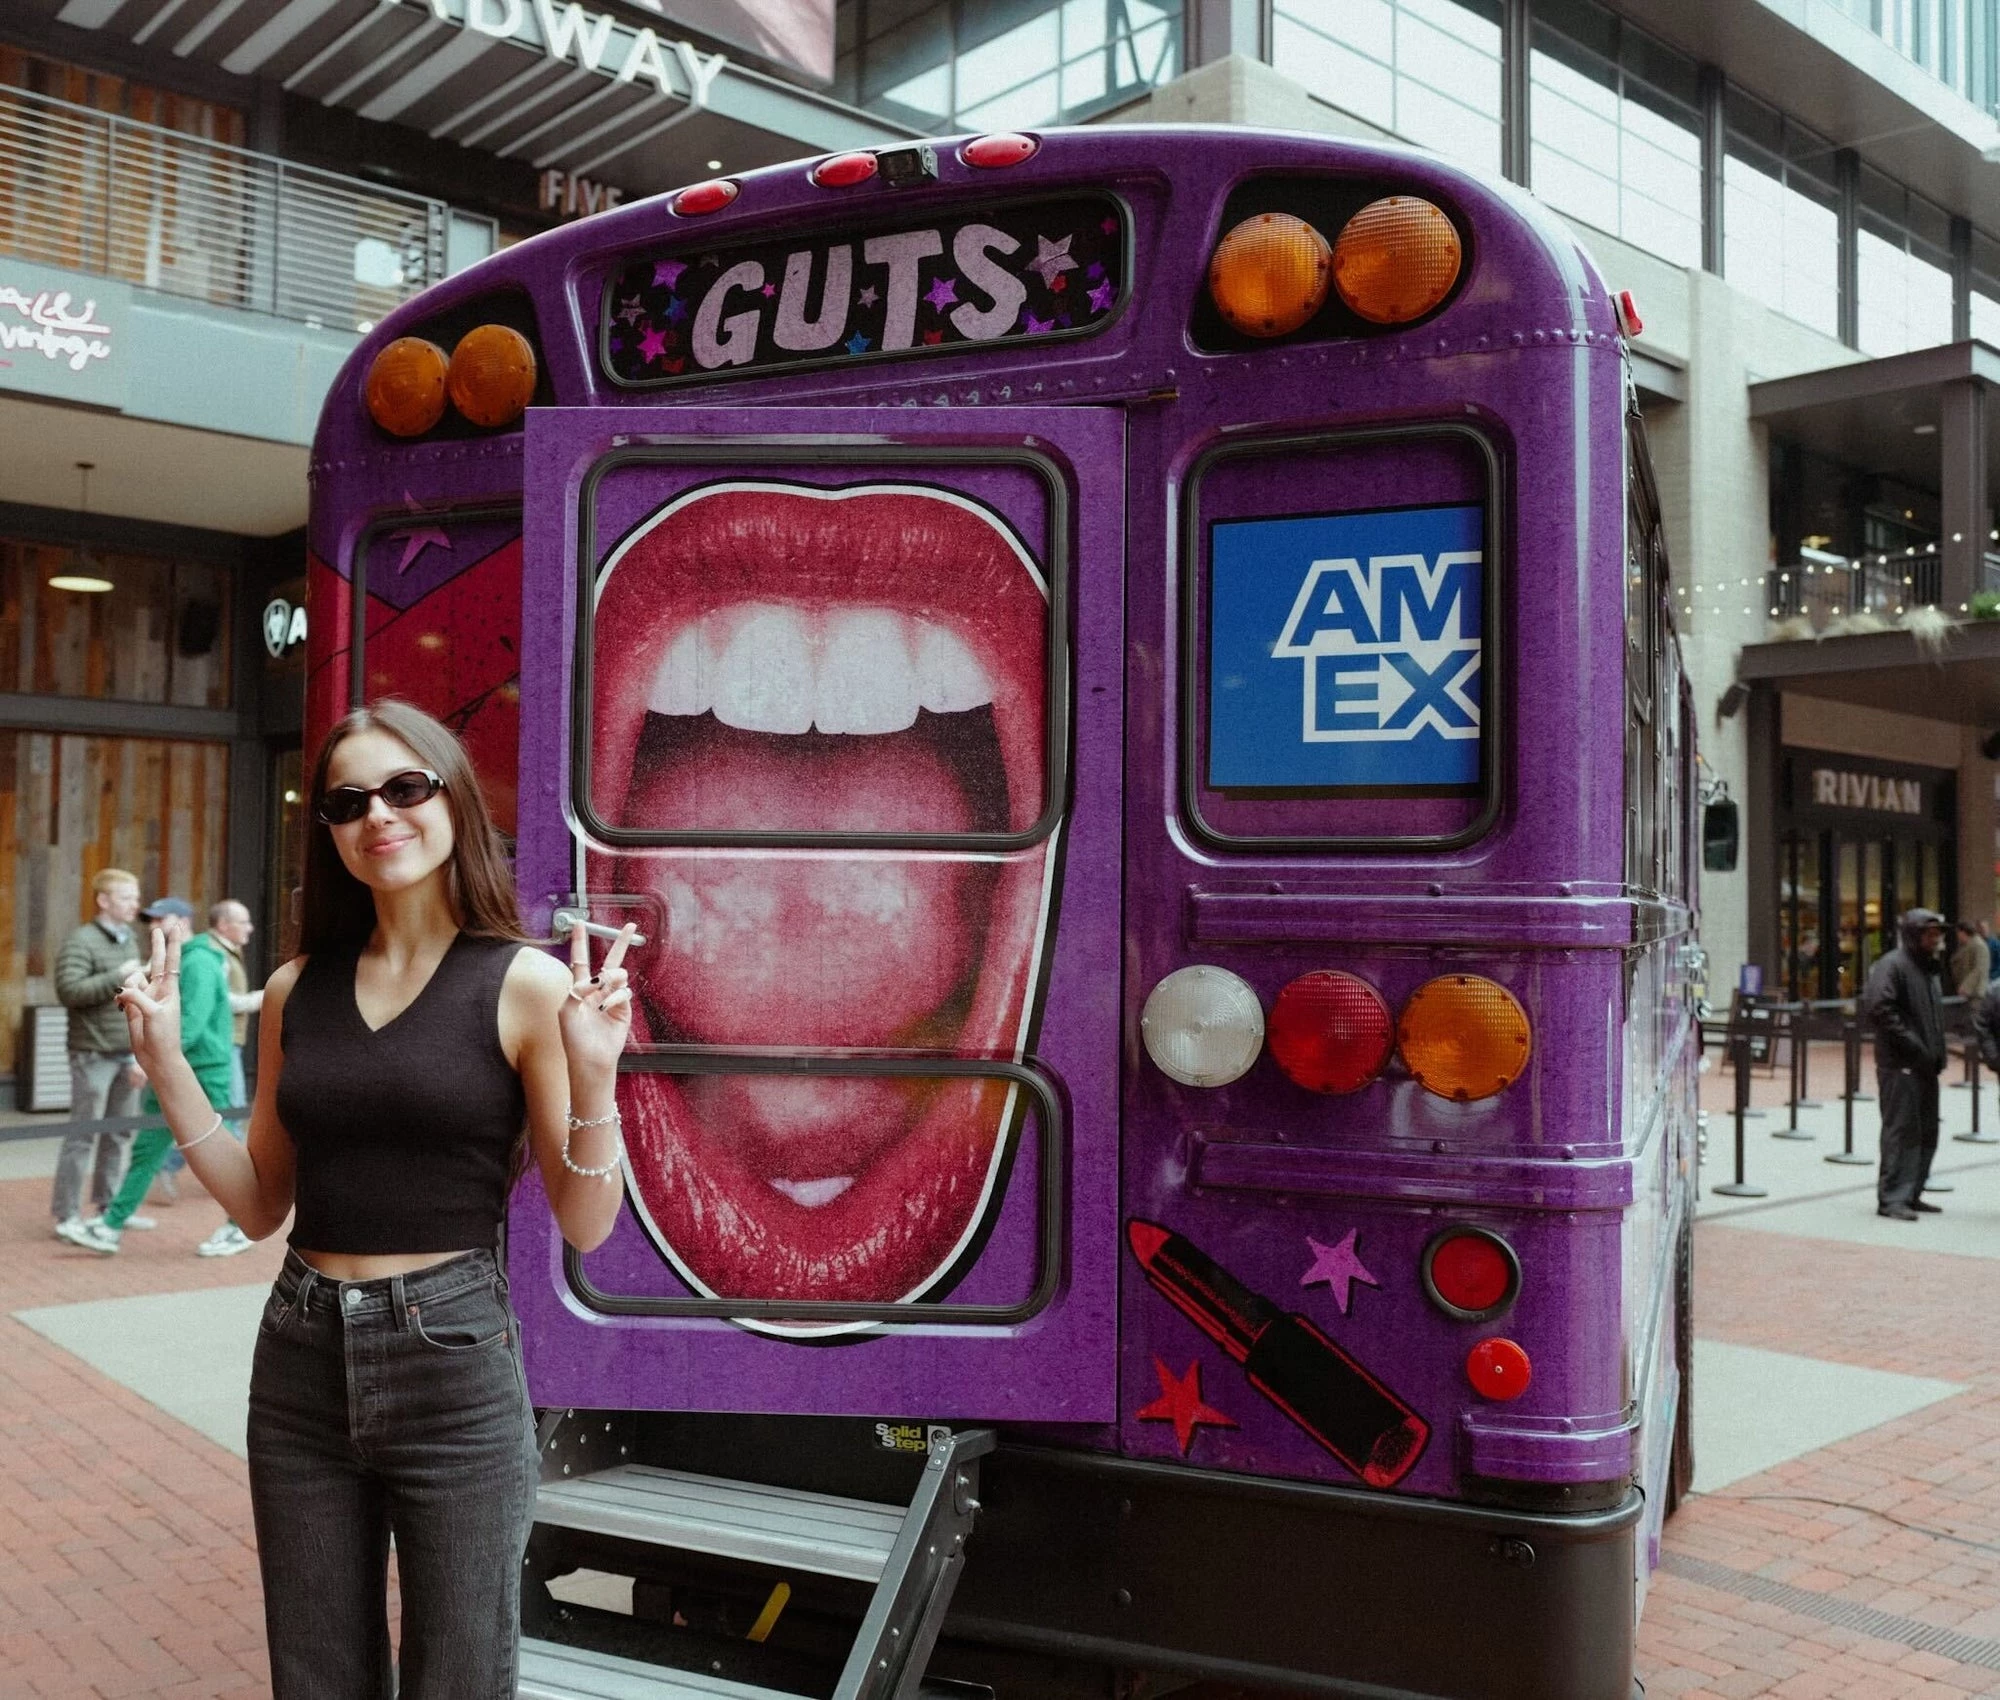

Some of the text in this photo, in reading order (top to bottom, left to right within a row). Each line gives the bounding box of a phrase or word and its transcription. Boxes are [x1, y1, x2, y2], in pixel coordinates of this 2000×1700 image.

[692, 223, 1027, 369] GUTS
[1813, 769, 1920, 814] RIVIAN
[875, 1423, 922, 1439] Solid
[881, 1435, 927, 1452] Step
